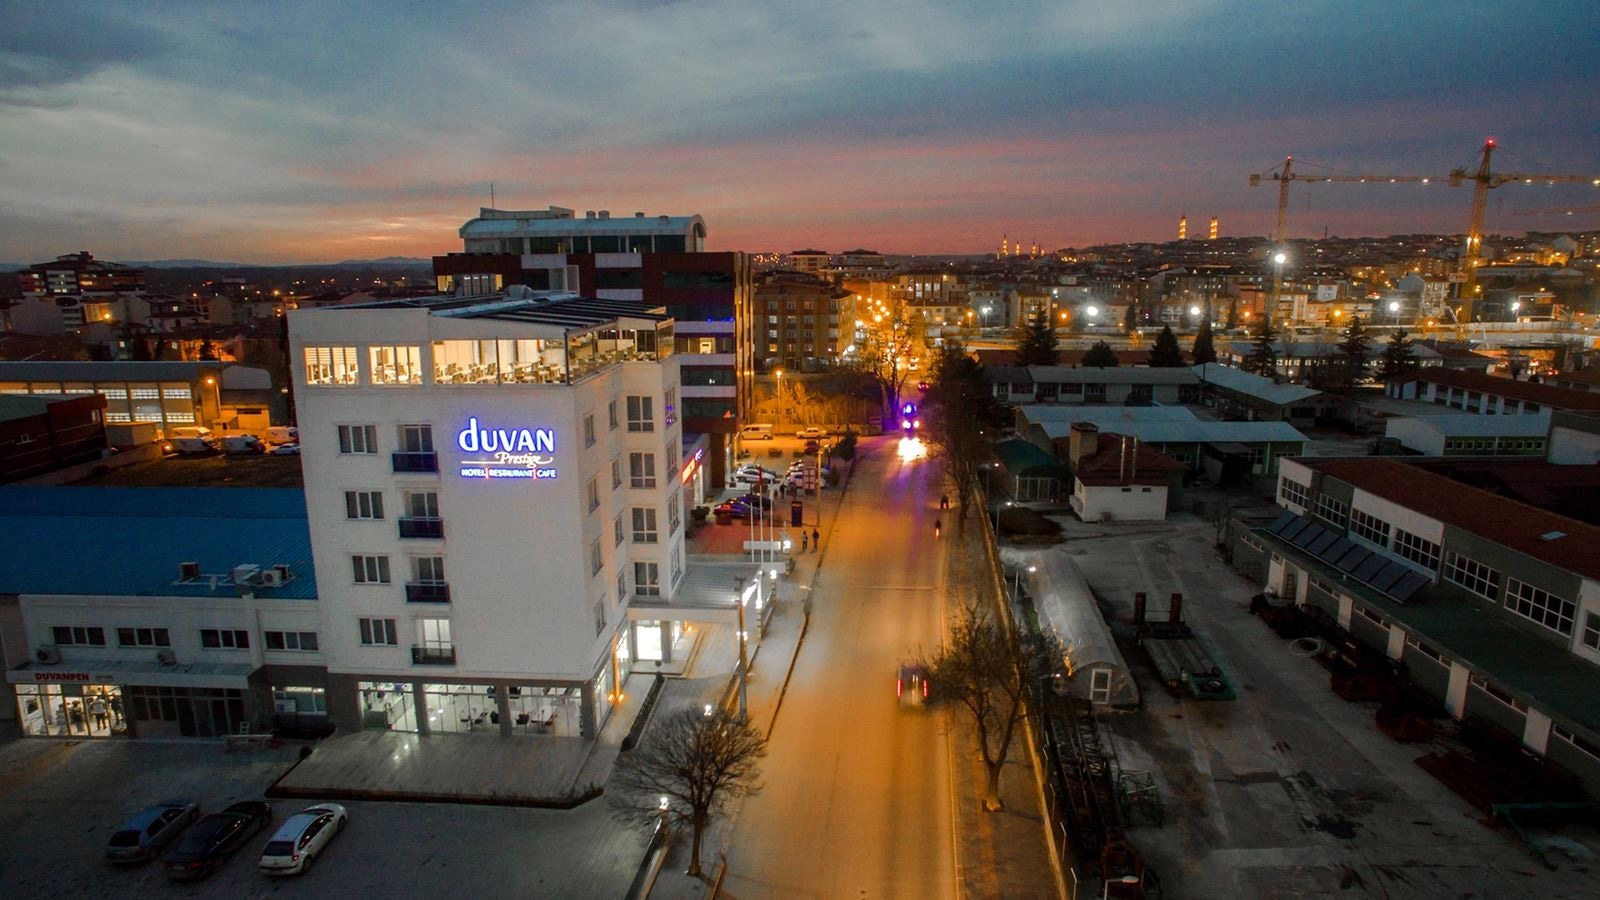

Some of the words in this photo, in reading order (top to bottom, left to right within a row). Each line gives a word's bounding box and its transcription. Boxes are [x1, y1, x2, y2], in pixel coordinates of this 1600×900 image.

[494, 452, 553, 468] Prestige
[461, 468, 486, 477] HOTEL
[489, 468, 533, 478] RESTAURANT
[536, 469, 556, 478] CAFE
[35, 673, 90, 681] DUVANPEN
